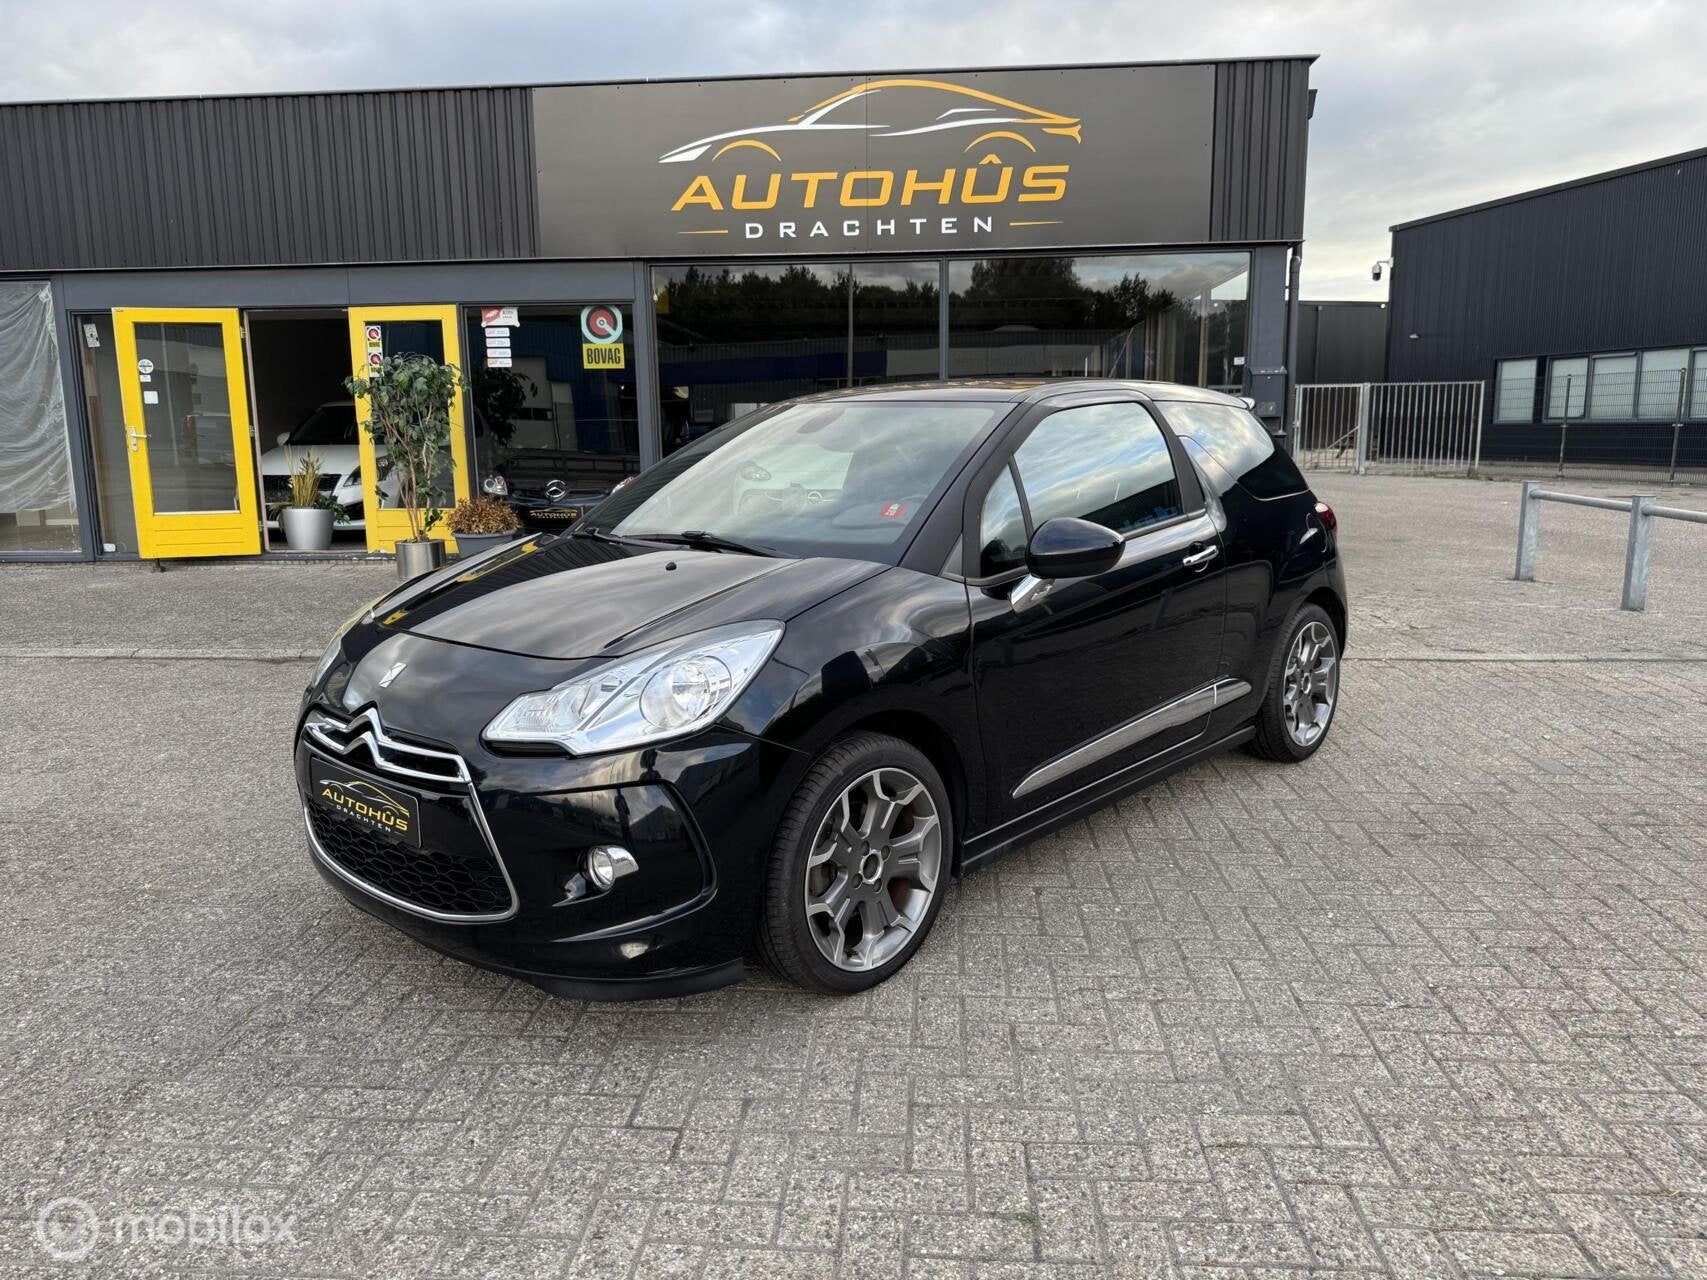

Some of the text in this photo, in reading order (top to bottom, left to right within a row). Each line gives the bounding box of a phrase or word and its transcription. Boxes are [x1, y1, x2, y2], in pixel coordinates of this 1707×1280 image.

[671, 154, 1069, 211] AUTOHÛS
[745, 217, 992, 240] DRACHTEN
[587, 348, 621, 364] BOVAG
[322, 788, 408, 831] AUTOHÛS
[336, 804, 391, 832] DRACHTEN
